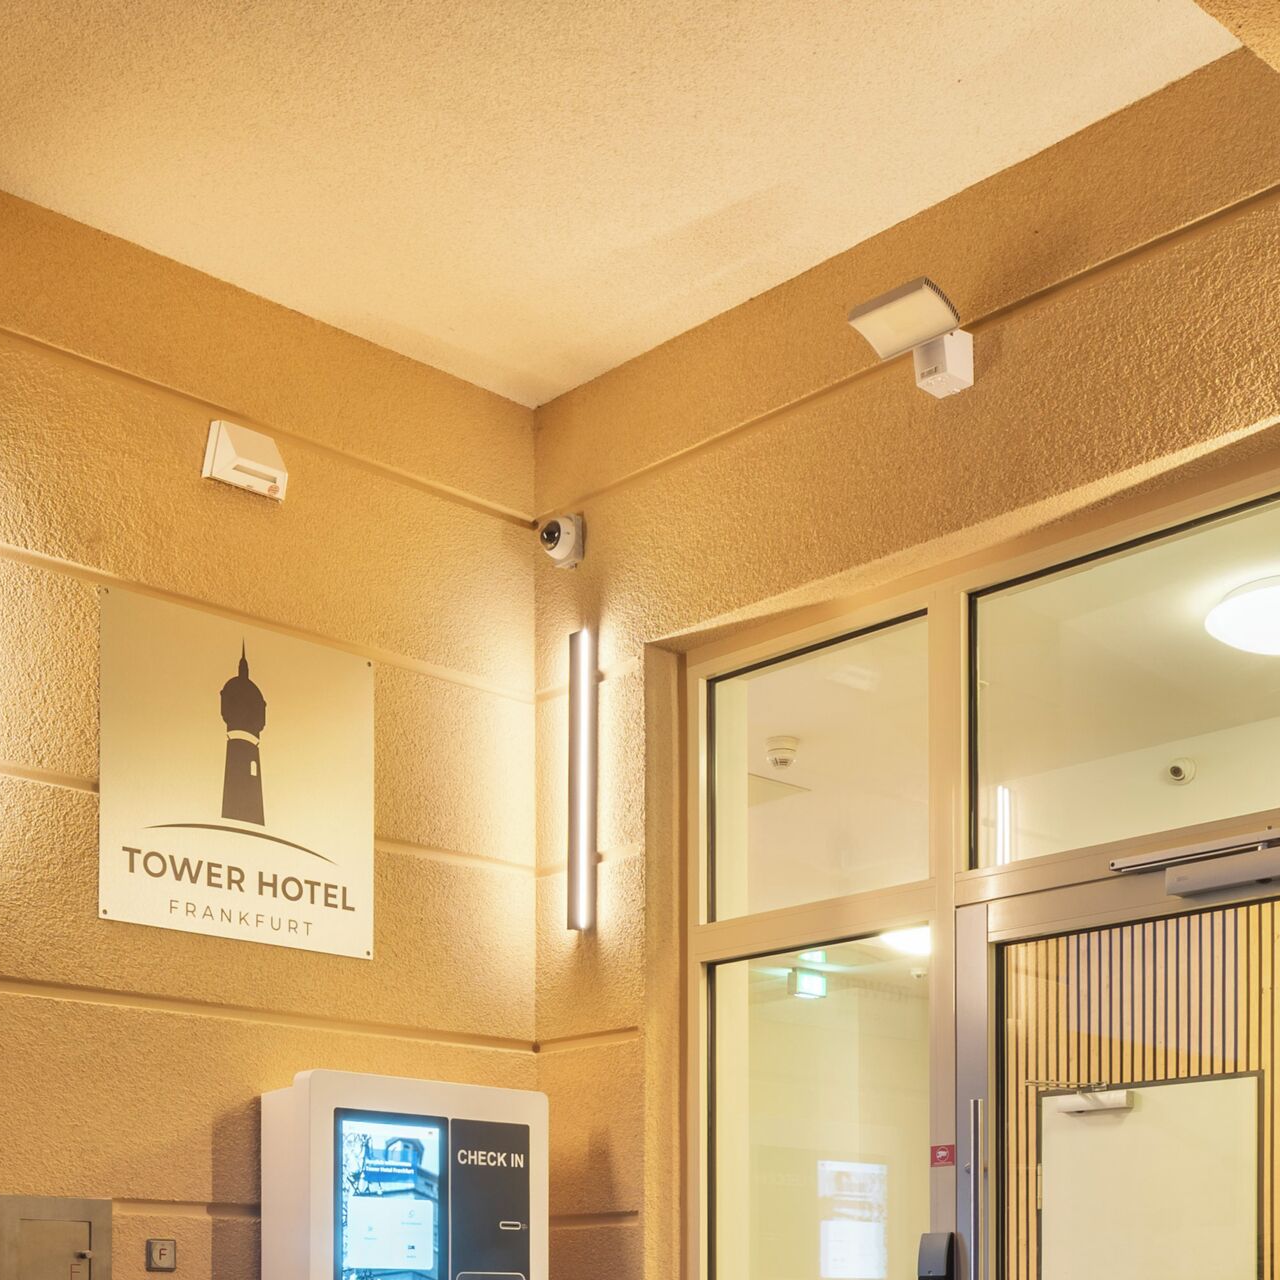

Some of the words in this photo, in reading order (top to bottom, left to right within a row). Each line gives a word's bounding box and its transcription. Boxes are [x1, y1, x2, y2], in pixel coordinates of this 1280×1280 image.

[122, 846, 246, 893] TOWER
[257, 871, 356, 912] HOTEL
[169, 899, 313, 937] FRANKFURT
[457, 1149, 508, 1168] CHECK
[510, 1152, 524, 1169] IN
[159, 1248, 168, 1261] F
[70, 1263, 81, 1280] F
